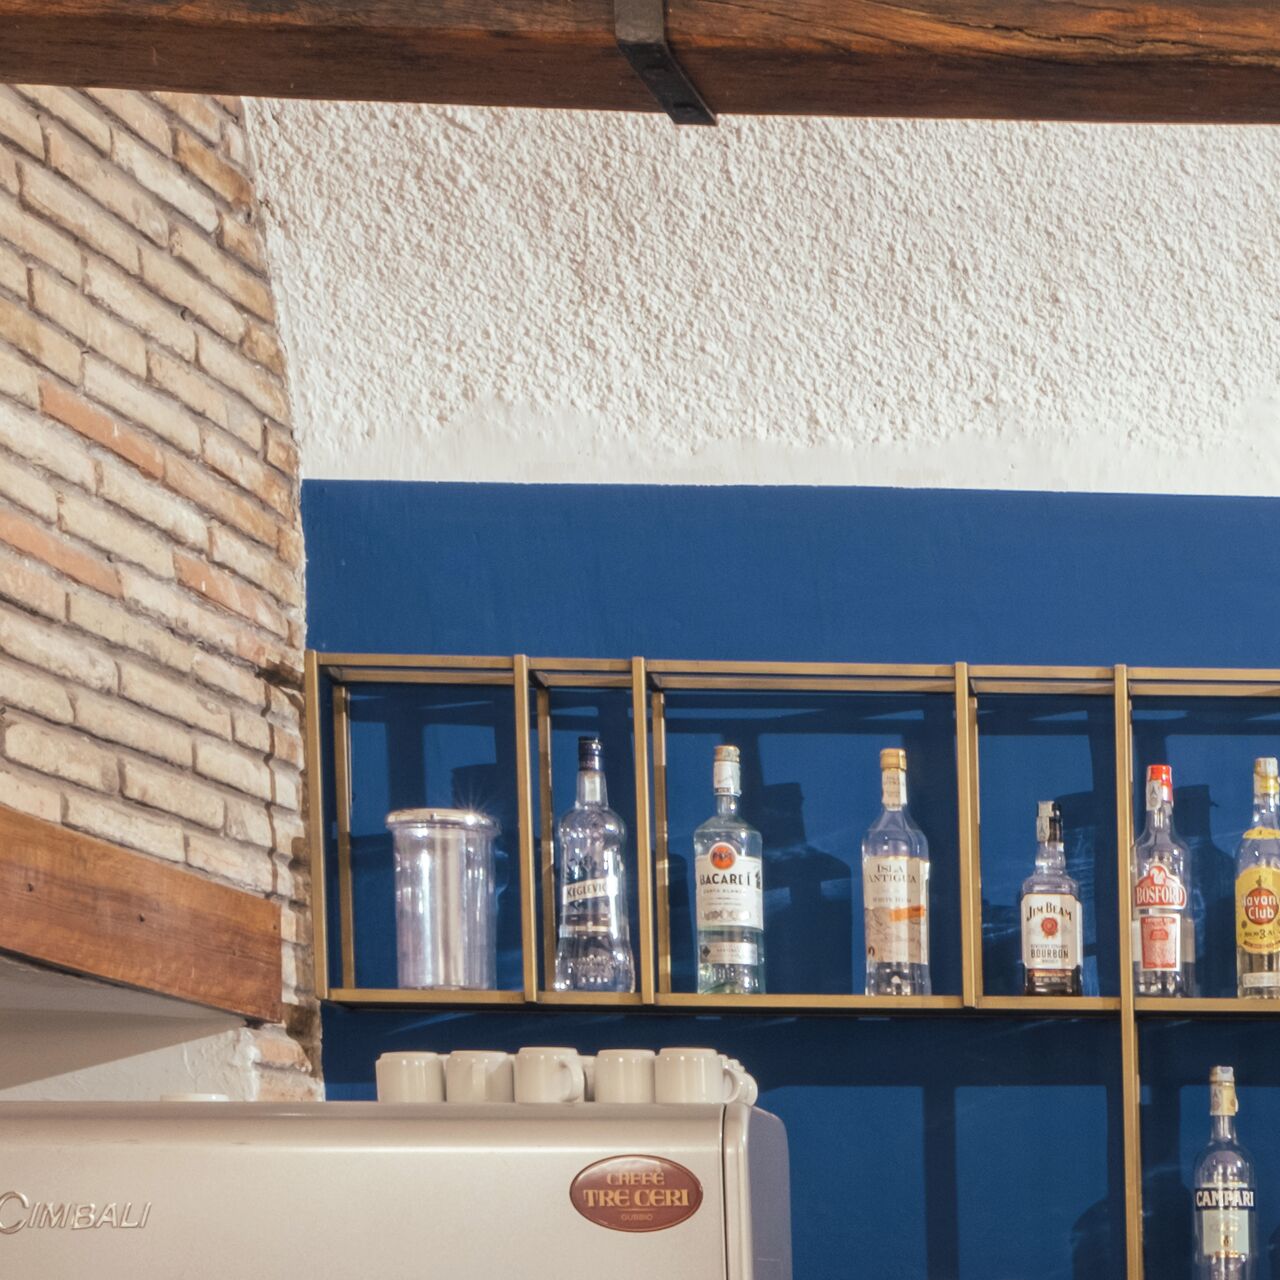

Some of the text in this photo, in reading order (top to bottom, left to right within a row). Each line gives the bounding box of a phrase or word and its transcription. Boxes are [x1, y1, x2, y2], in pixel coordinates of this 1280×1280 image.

[567, 880, 611, 899] KEGLEVIC
[1136, 886, 1184, 904] BOSFORD
[1026, 902, 1072, 921] JIM BEAM
[1248, 907, 1275, 919] Club
[1030, 948, 1069, 959] BOURBON
[583, 1189, 689, 1207] TRE CERI
[1196, 1190, 1254, 1207] CAMPARI
